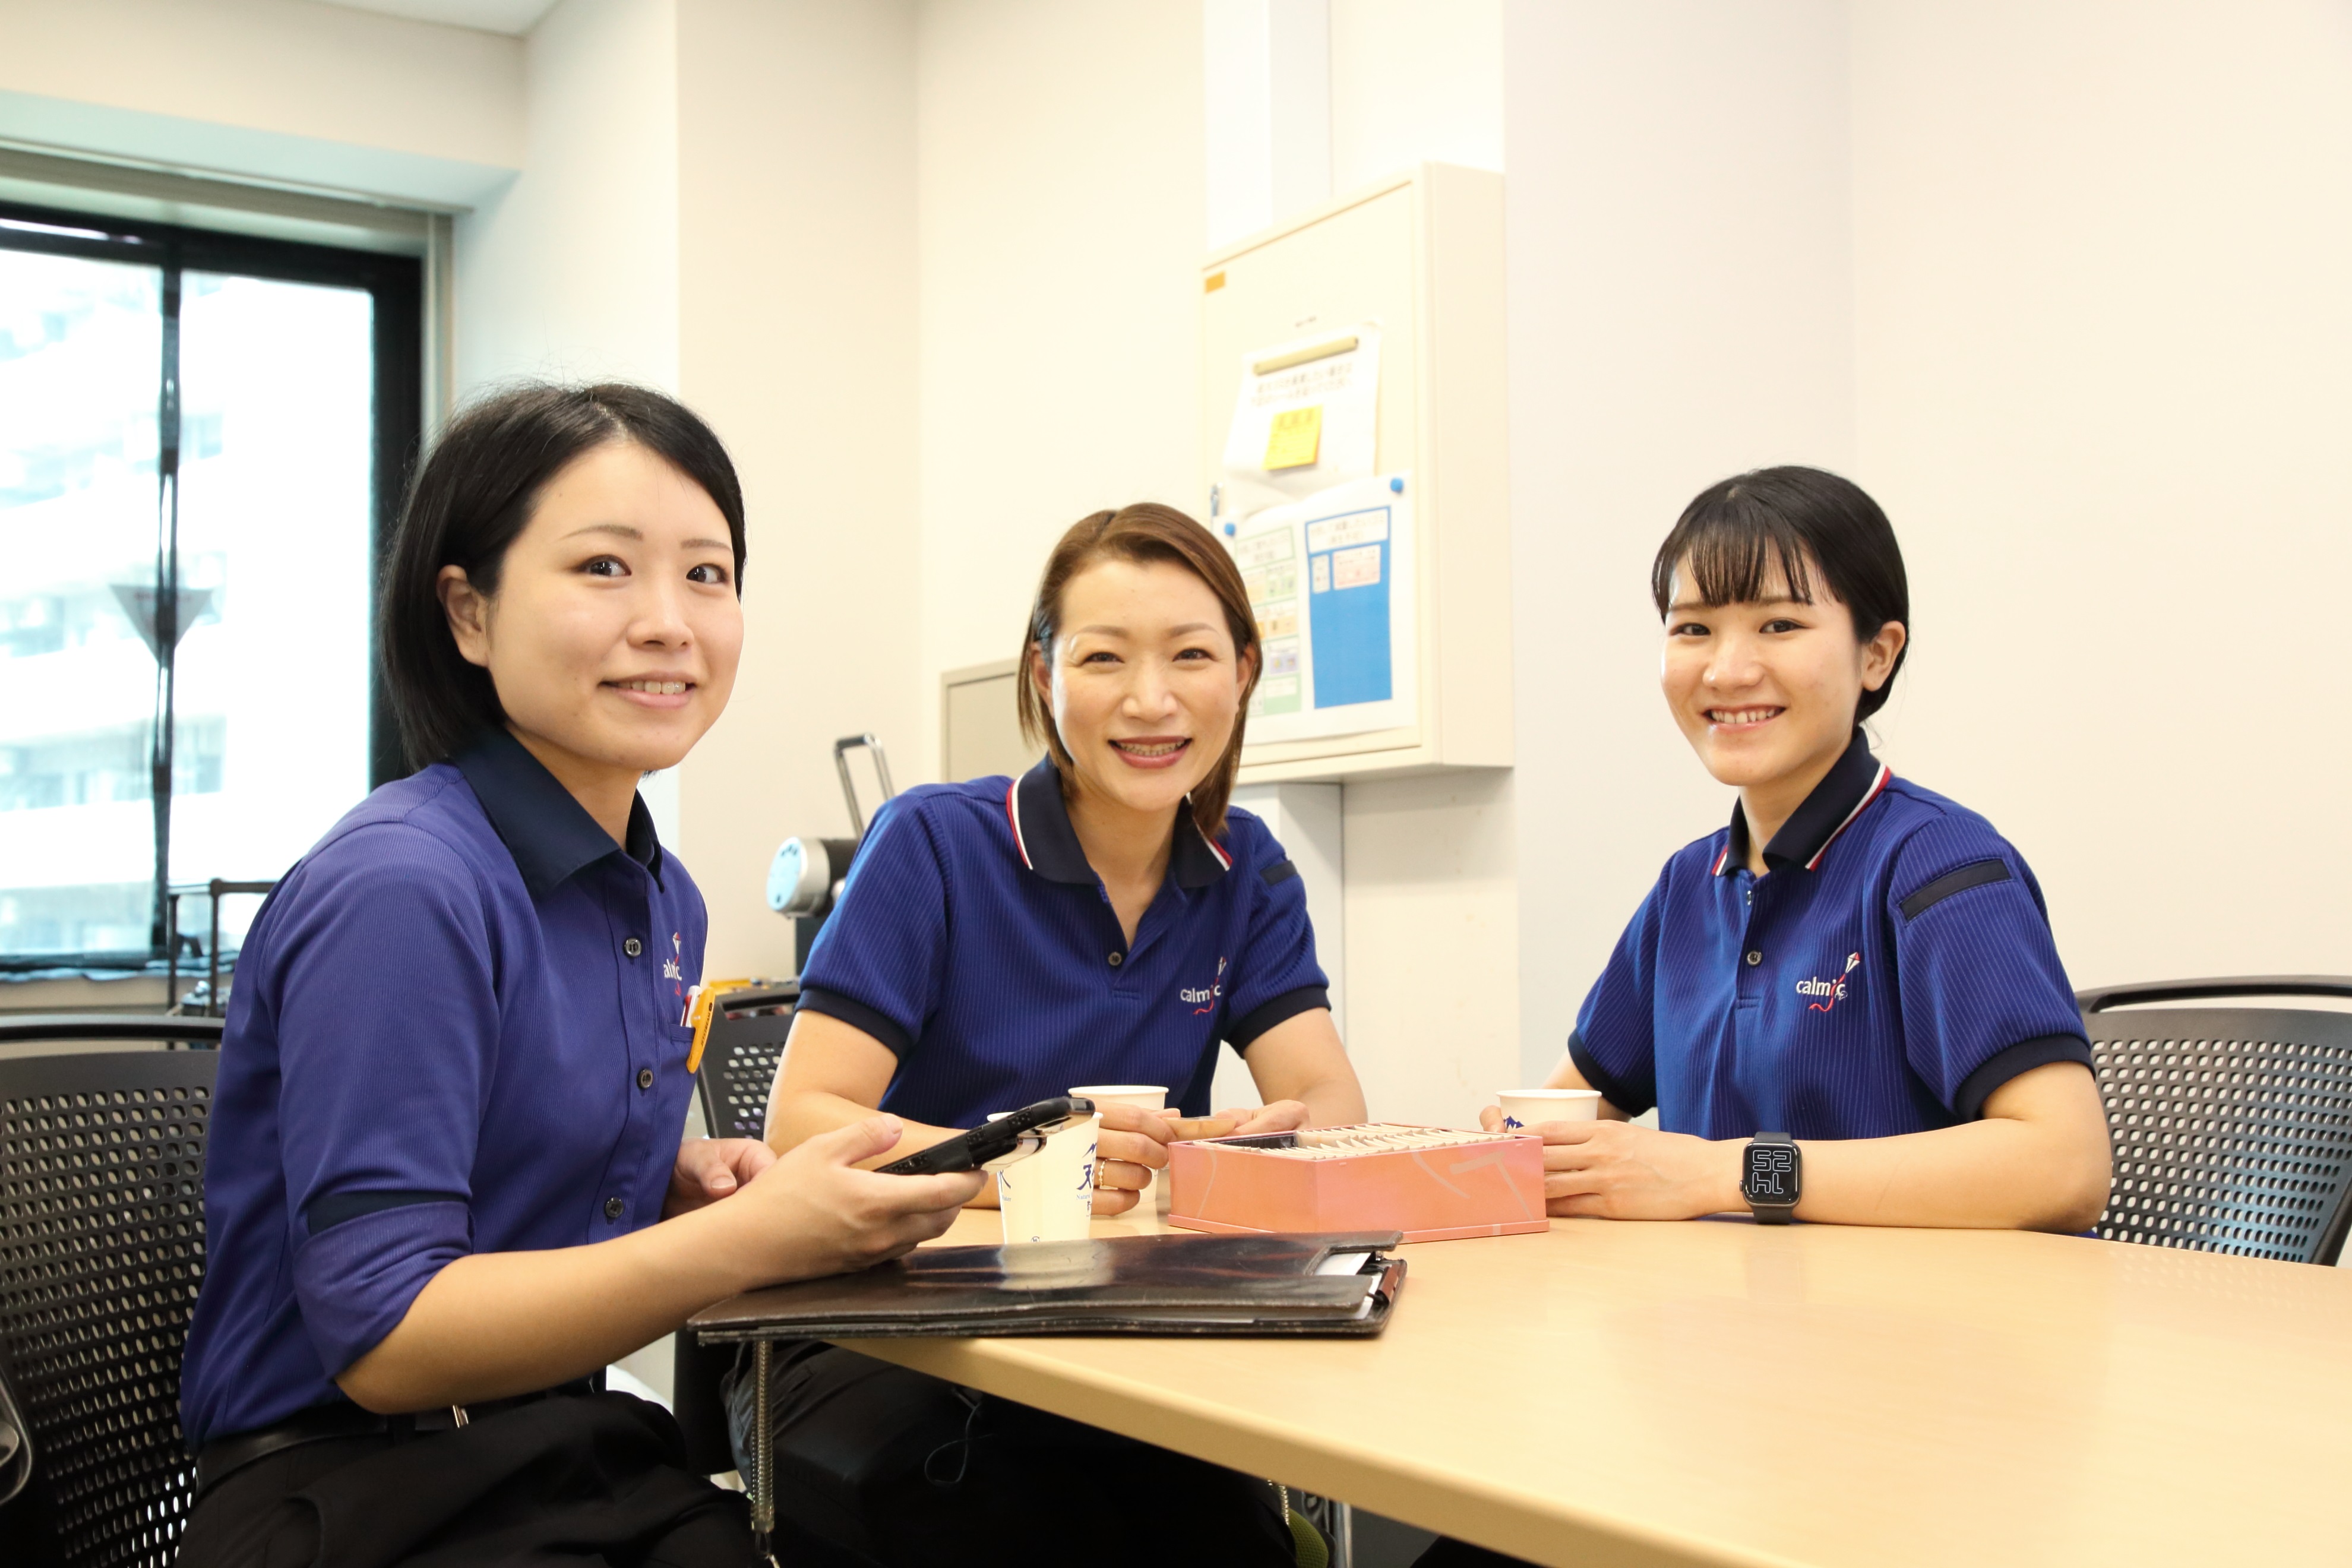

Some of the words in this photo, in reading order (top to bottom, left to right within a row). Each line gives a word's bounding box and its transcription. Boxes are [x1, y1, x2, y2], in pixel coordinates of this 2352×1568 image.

[1180, 984, 1221, 1003] calmic
[1796, 976, 1845, 997] calmic
[1076, 1164, 1094, 1190] 天
